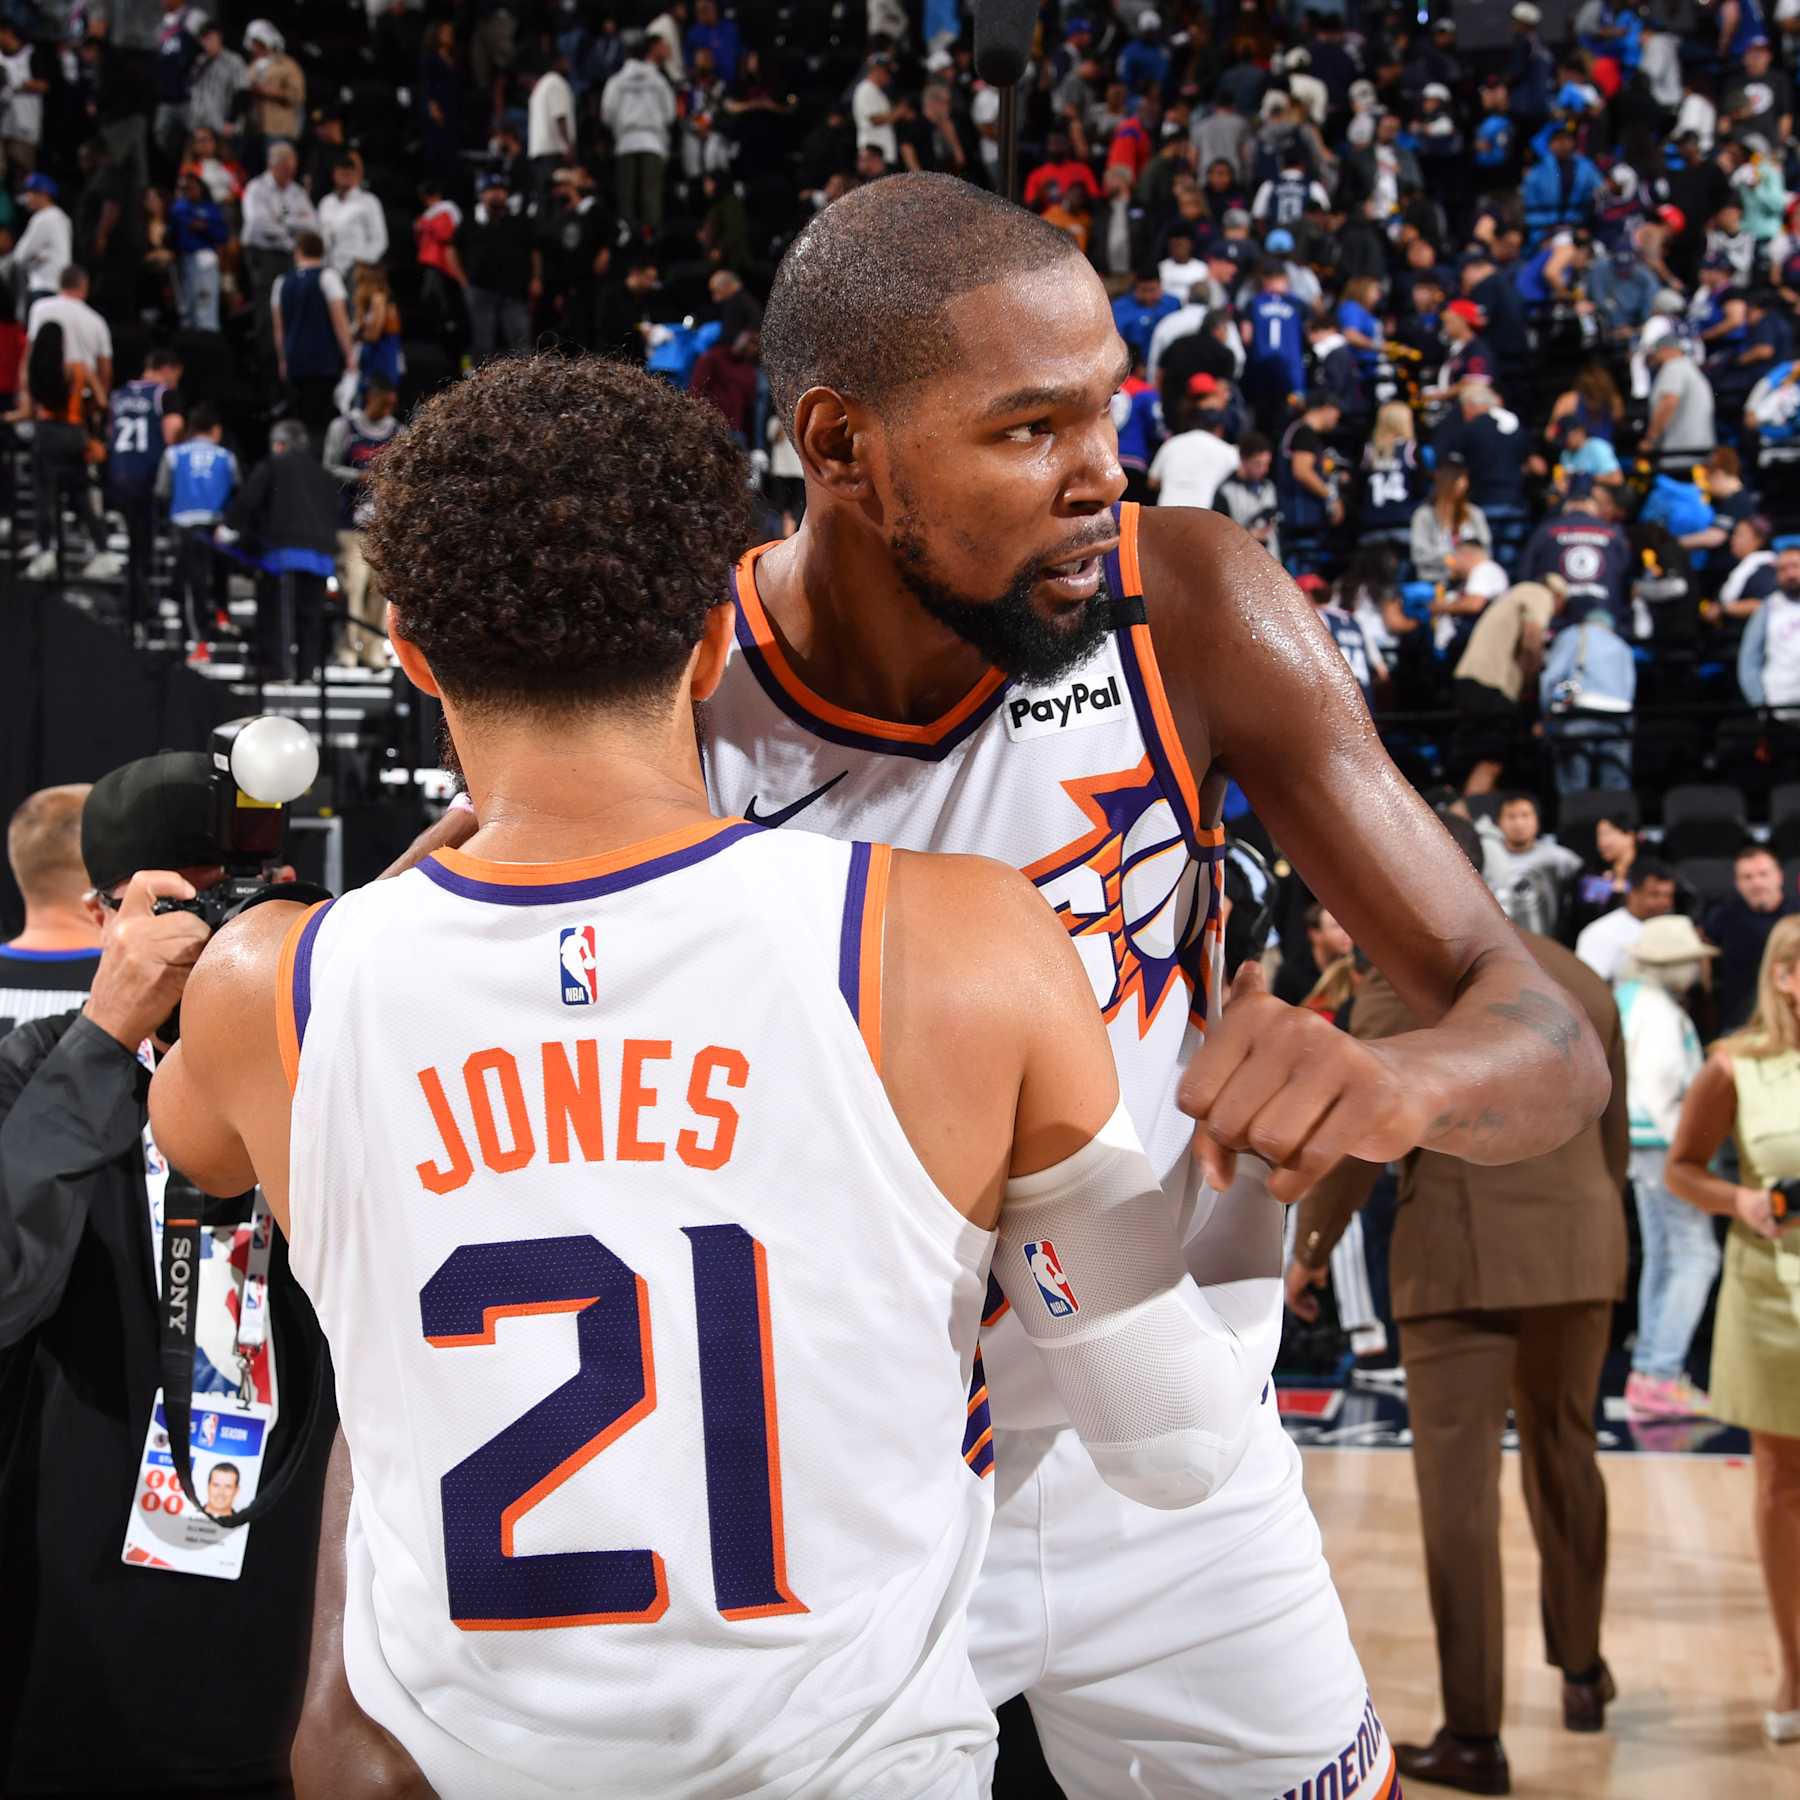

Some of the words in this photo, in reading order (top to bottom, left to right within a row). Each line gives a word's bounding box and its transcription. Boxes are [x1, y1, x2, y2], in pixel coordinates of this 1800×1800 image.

[114, 416, 149, 453] 21
[1009, 676, 1122, 729] PayPal
[565, 986, 586, 1002] NBA
[416, 1039, 750, 1195] JONES
[168, 1237, 192, 1335] SONY
[1050, 1299, 1069, 1315] NBA
[419, 1223, 811, 1631] 21
[1272, 1687, 1382, 1800] OENI
